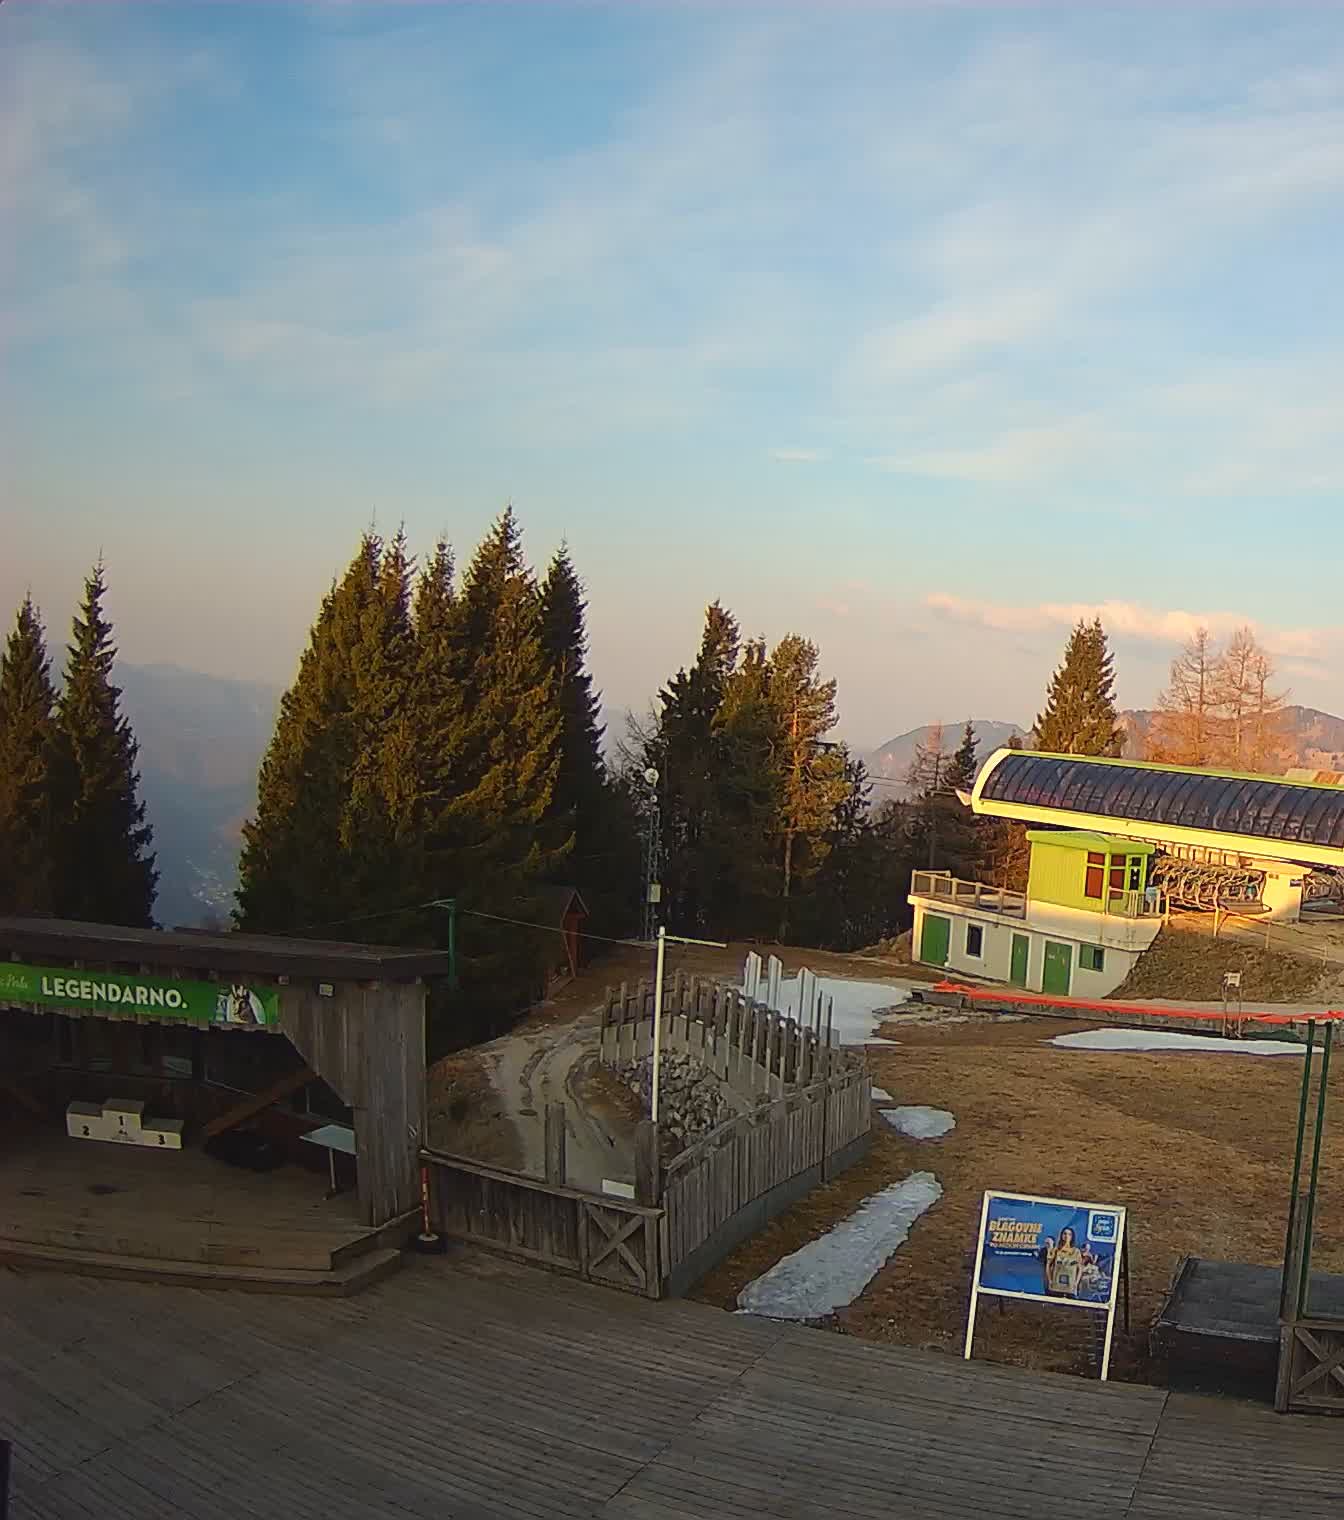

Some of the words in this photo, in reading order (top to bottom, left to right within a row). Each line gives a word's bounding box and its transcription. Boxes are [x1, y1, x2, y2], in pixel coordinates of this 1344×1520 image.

[41, 976, 187, 1009] LEGENDARNO.
[118, 1115, 124, 1126] 1
[82, 1125, 90, 1137] 2
[158, 1134, 166, 1146] 3
